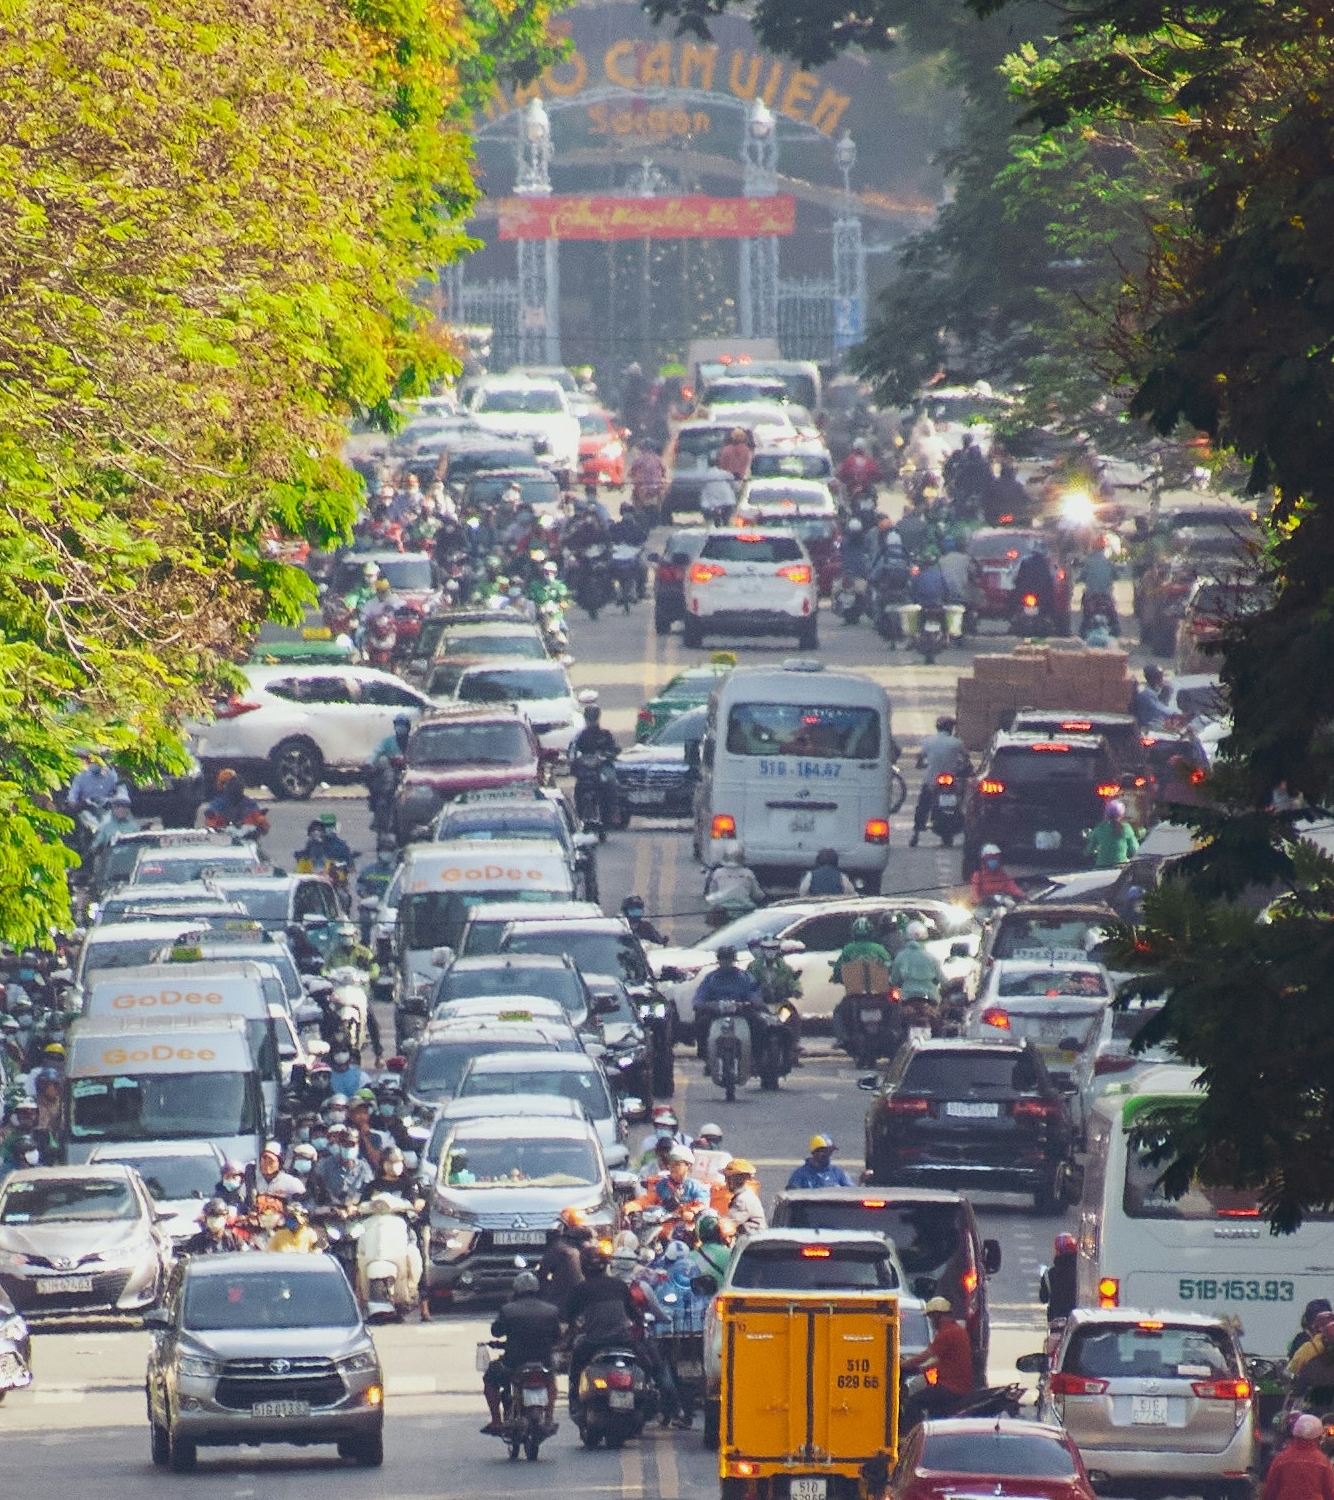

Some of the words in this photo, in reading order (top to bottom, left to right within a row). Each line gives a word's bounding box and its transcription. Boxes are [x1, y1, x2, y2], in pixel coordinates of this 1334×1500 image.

[440, 864, 543, 883] GoDee
[111, 989, 224, 1010] GoDee
[102, 1044, 216, 1065] GoDee
